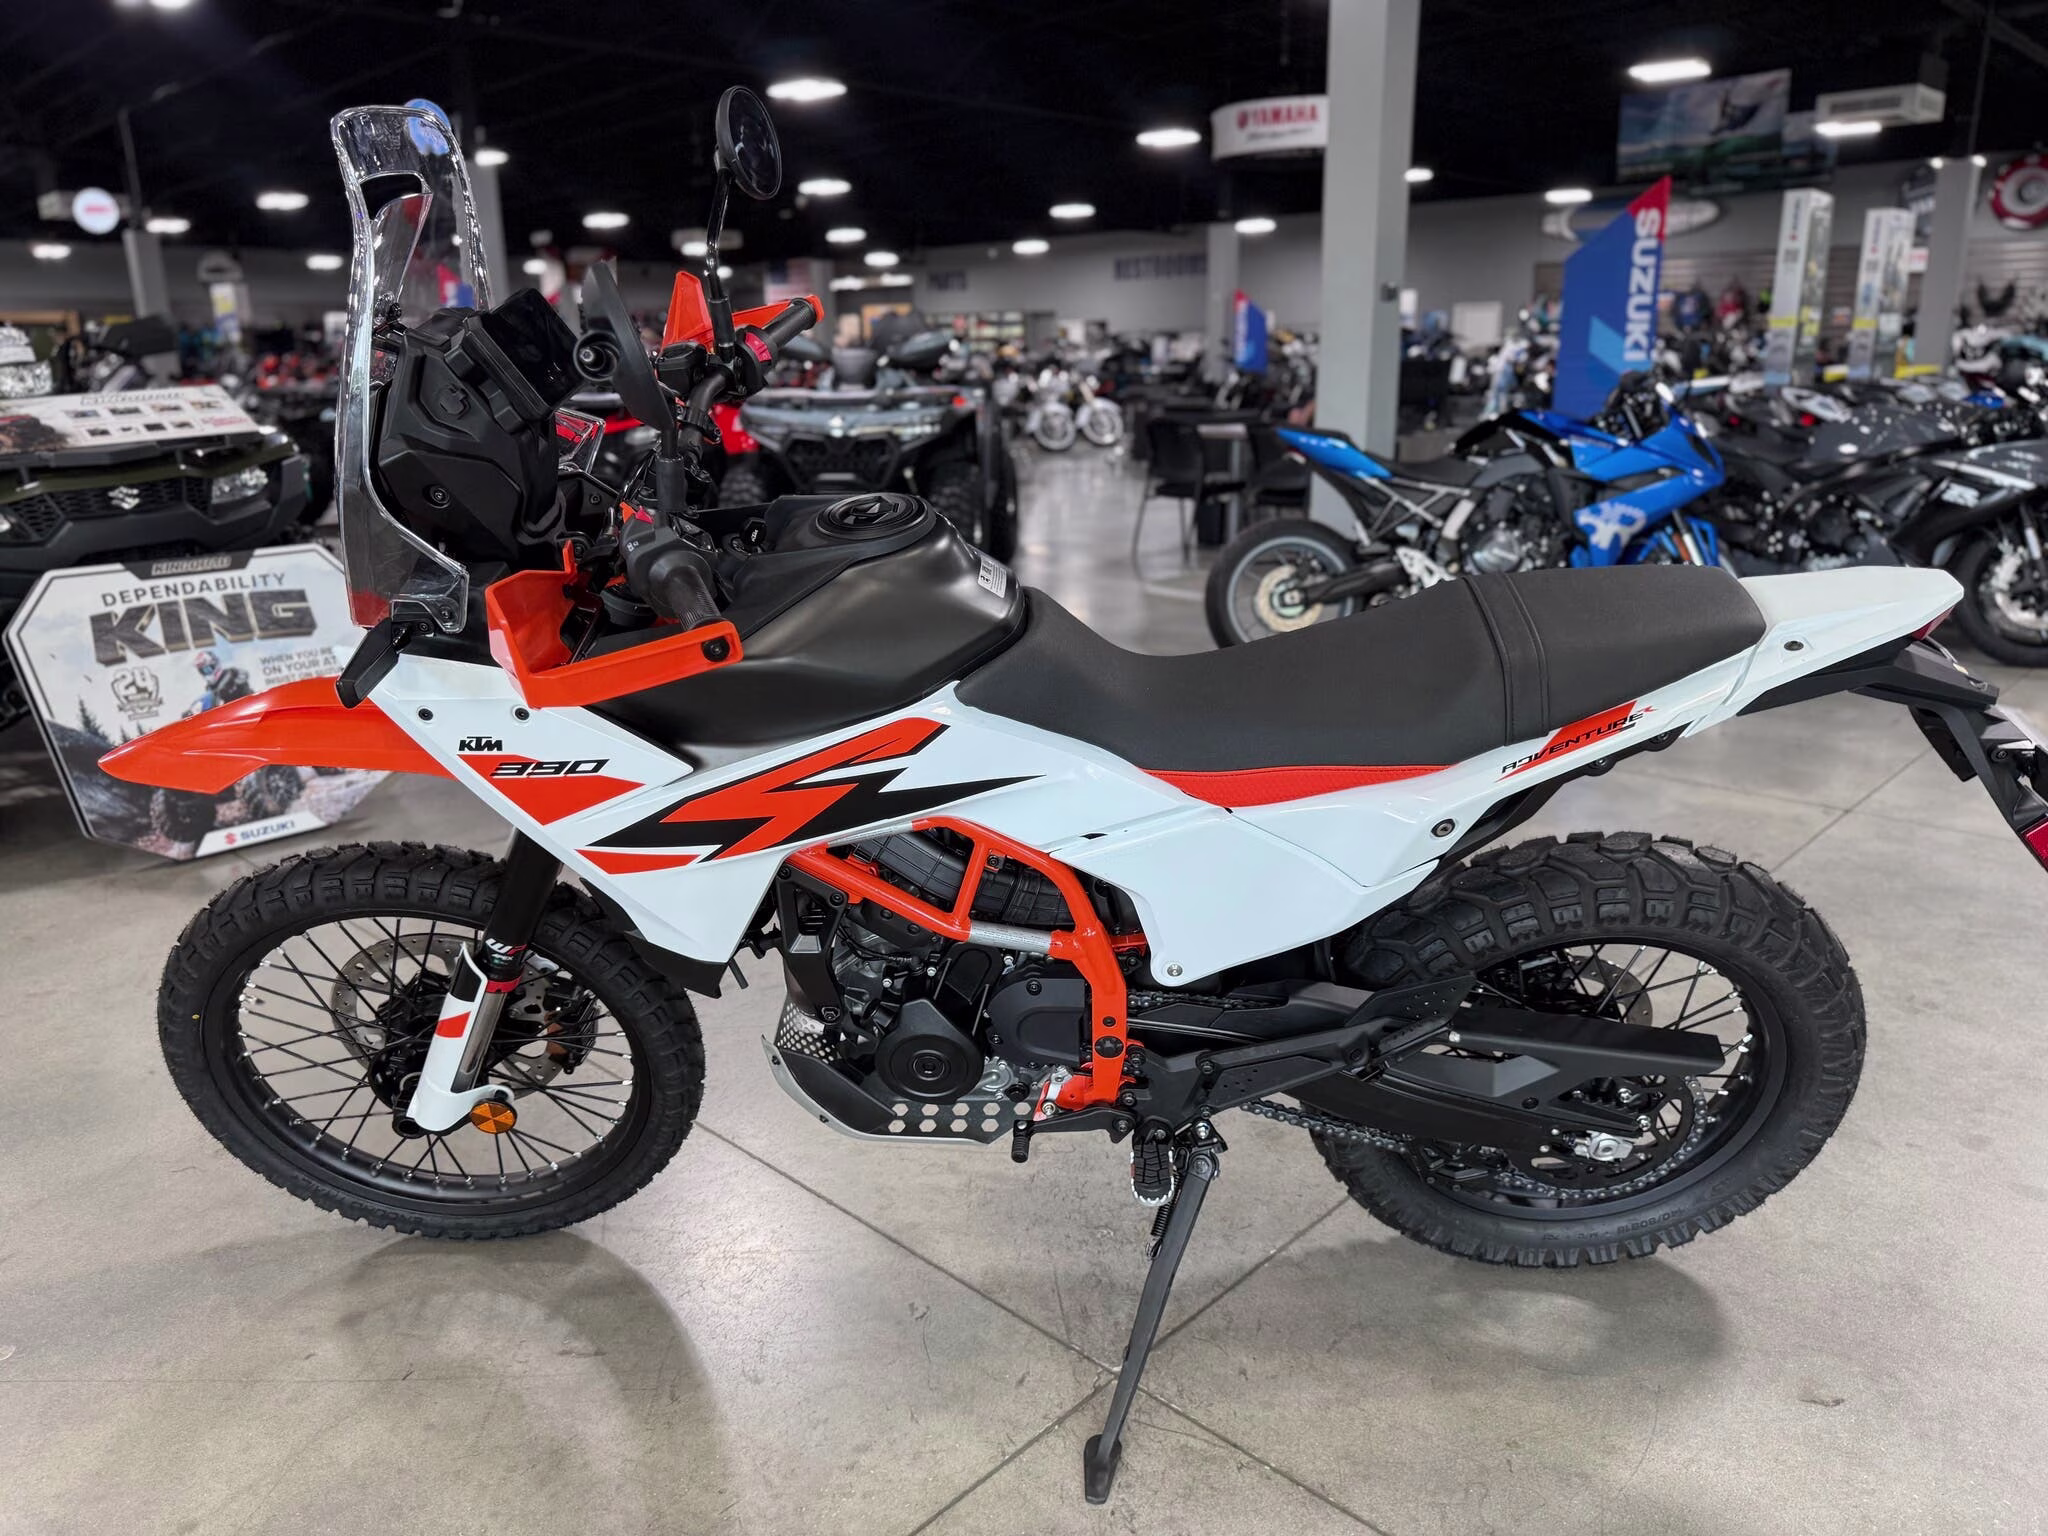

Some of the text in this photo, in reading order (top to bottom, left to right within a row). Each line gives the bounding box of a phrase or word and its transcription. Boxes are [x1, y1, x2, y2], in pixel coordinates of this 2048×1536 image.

[1250, 104, 1318, 126] YAMAHA
[1623, 208, 1662, 361] SUZUKI
[102, 573, 286, 607] DEPENDABILITY
[90, 589, 317, 667] KING
[285, 659, 319, 671] YOUR
[458, 736, 503, 751] KTM
[1501, 712, 1644, 774] ADVENTURE
[490, 758, 610, 777] 390
[240, 820, 296, 840] SUZUKI
